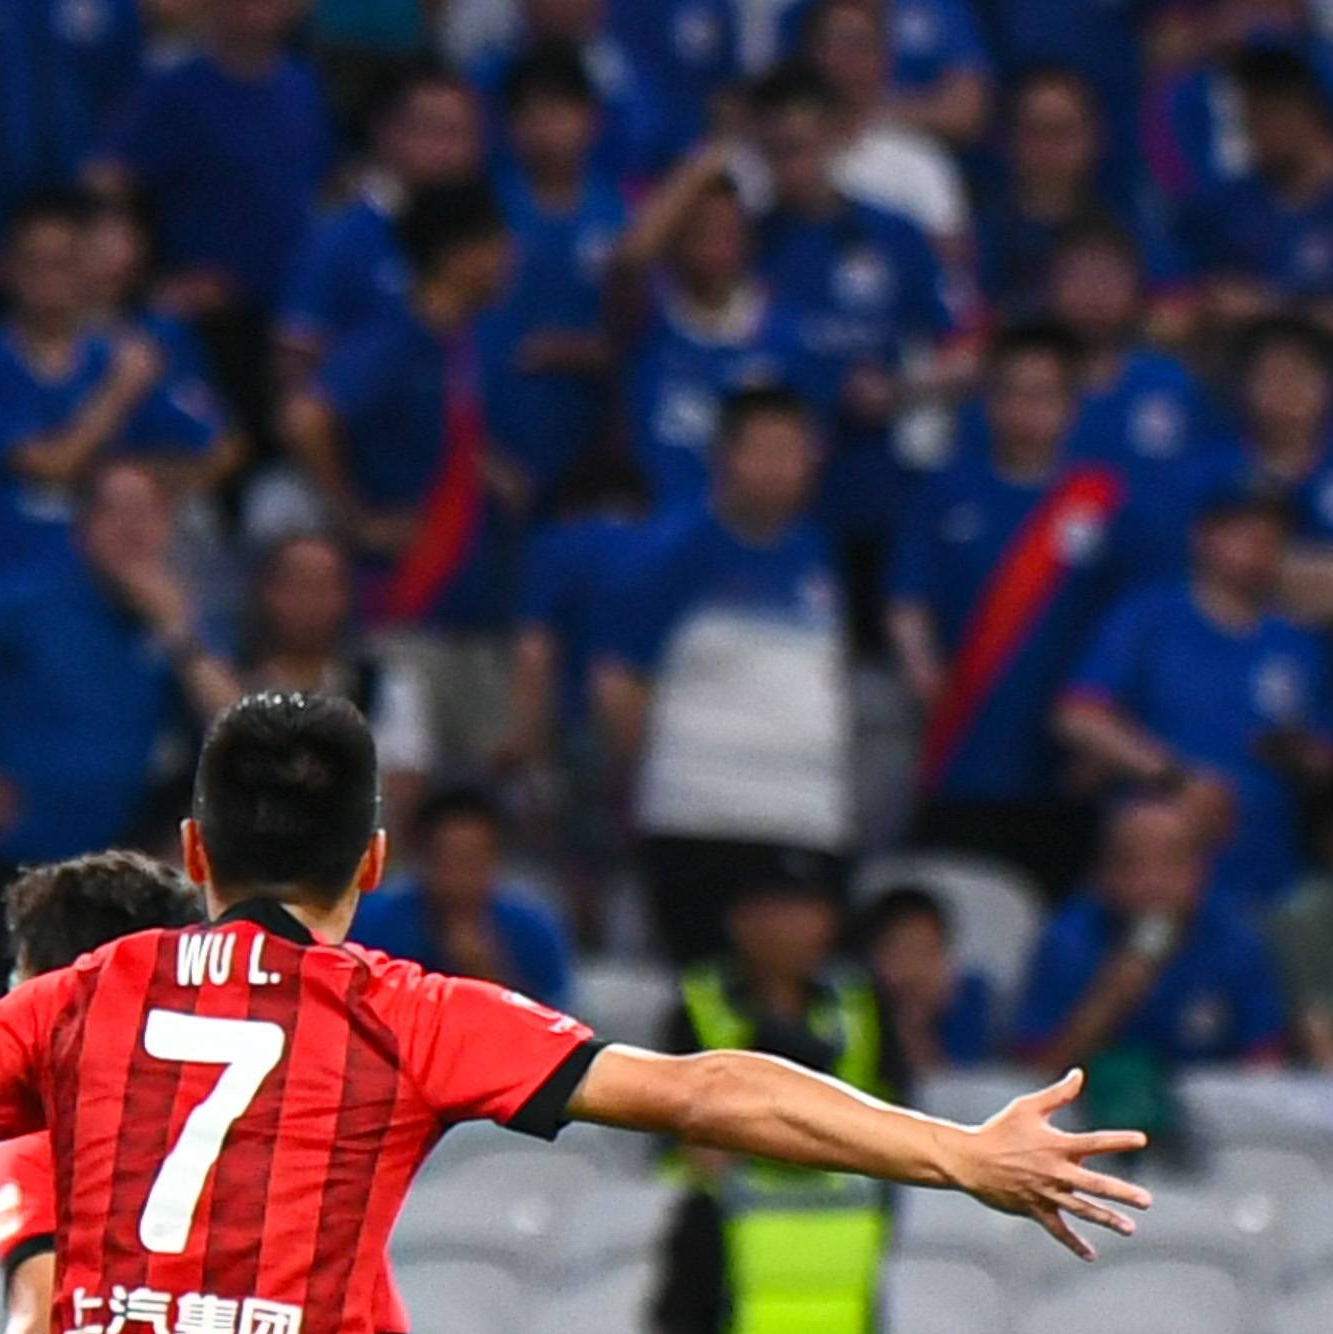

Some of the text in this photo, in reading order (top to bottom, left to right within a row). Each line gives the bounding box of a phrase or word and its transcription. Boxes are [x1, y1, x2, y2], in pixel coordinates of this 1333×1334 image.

[177, 931, 282, 986] WU L.
[139, 1008, 286, 1254] 7
